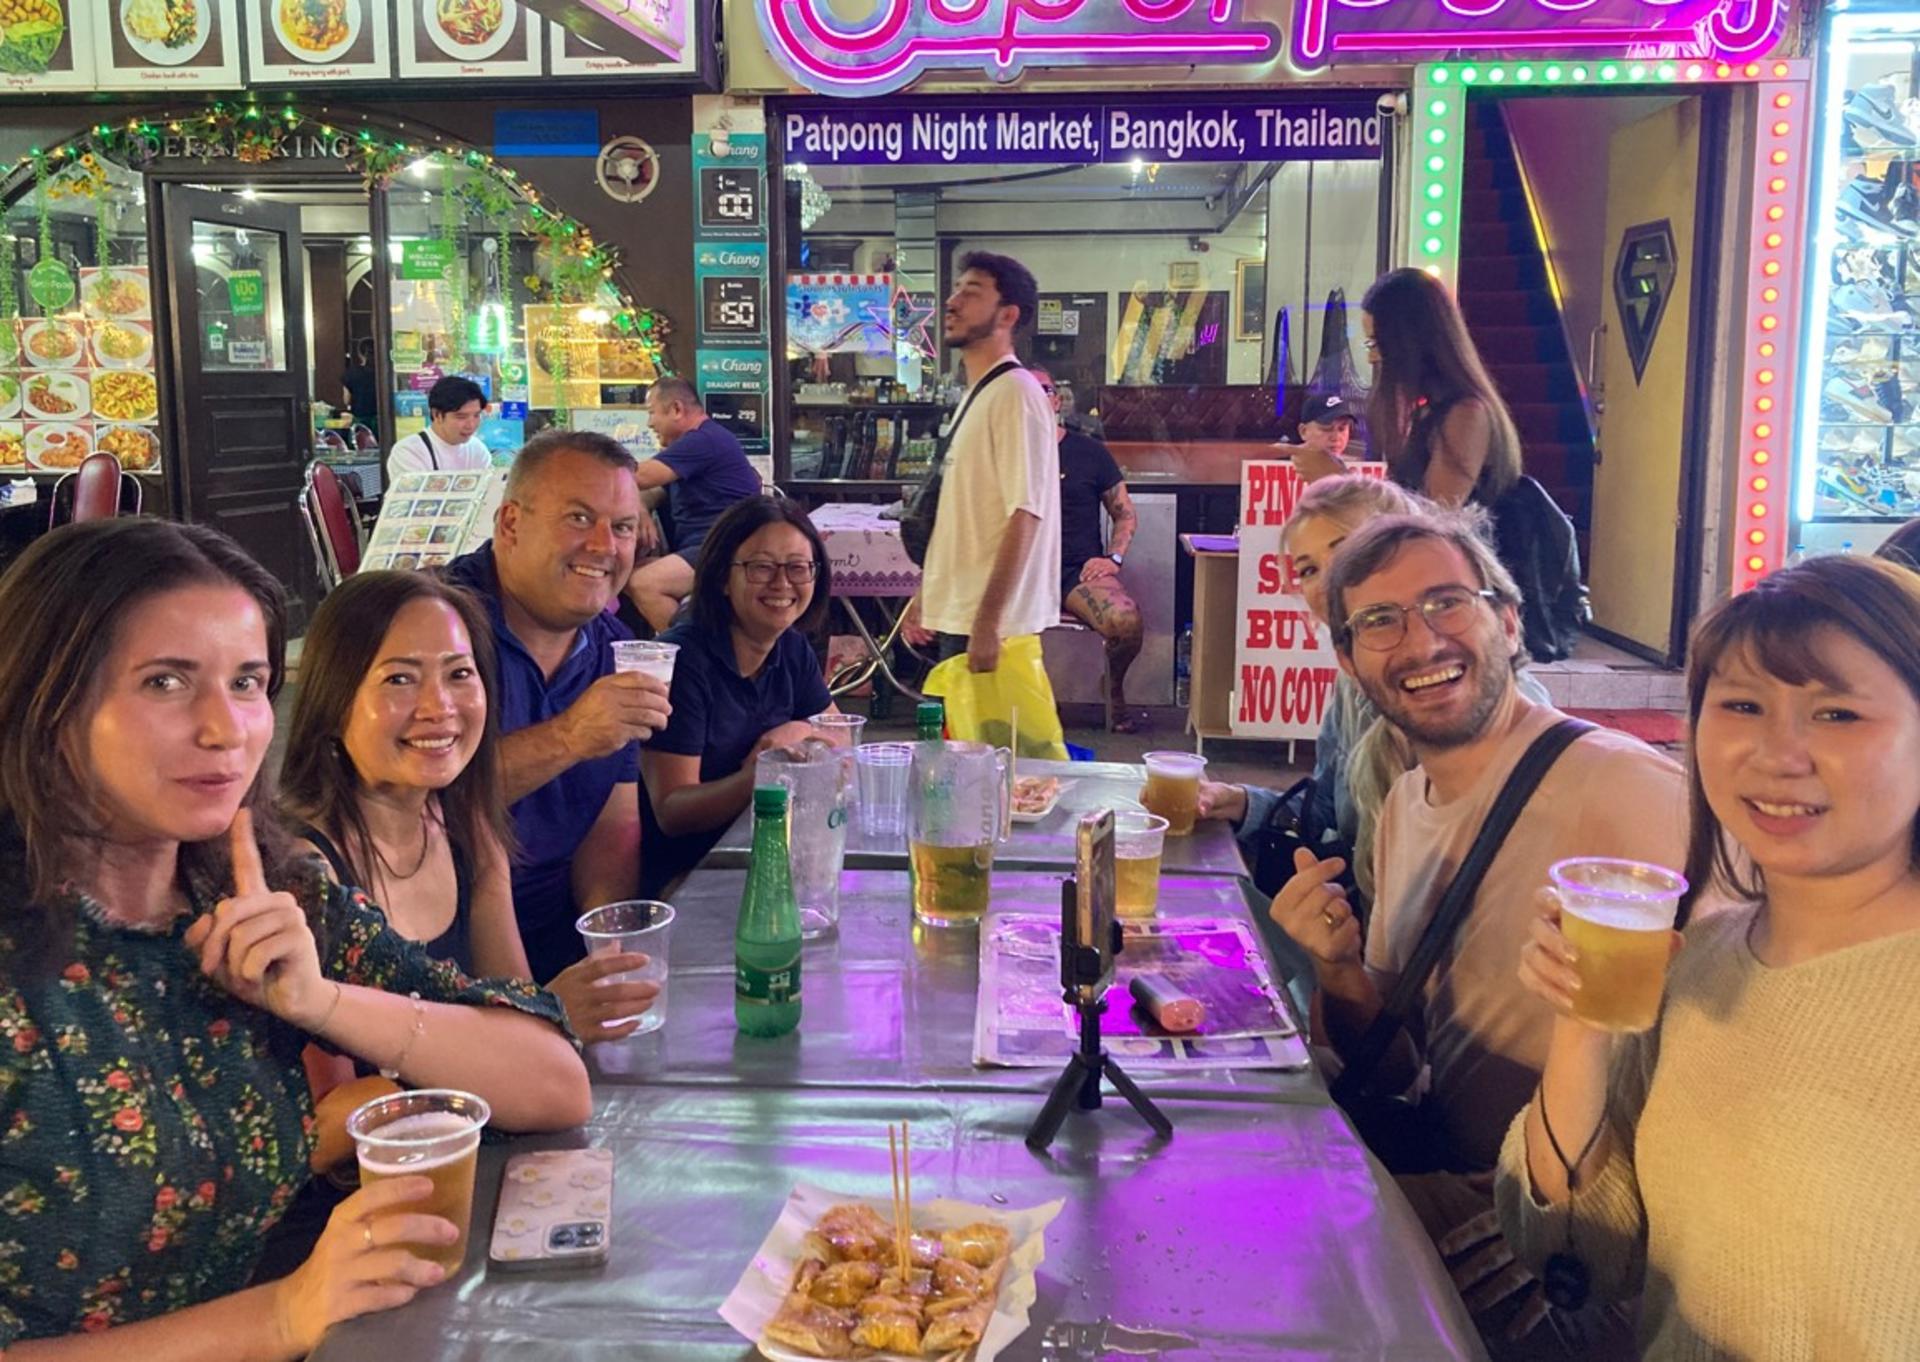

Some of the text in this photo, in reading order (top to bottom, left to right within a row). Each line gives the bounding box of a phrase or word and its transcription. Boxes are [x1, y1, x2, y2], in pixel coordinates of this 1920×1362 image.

[786, 108, 1381, 161] Patpong Night Market, Bangkok, Thailand
[273, 134, 350, 159] KING
[729, 143, 759, 159] hang
[719, 251, 760, 268] Chang
[720, 302, 755, 325] 150
[721, 358, 763, 375] Chang
[706, 381, 760, 390] DRAUGHT BEER
[1246, 464, 1304, 526] PIN
[1239, 664, 1277, 723] NO
